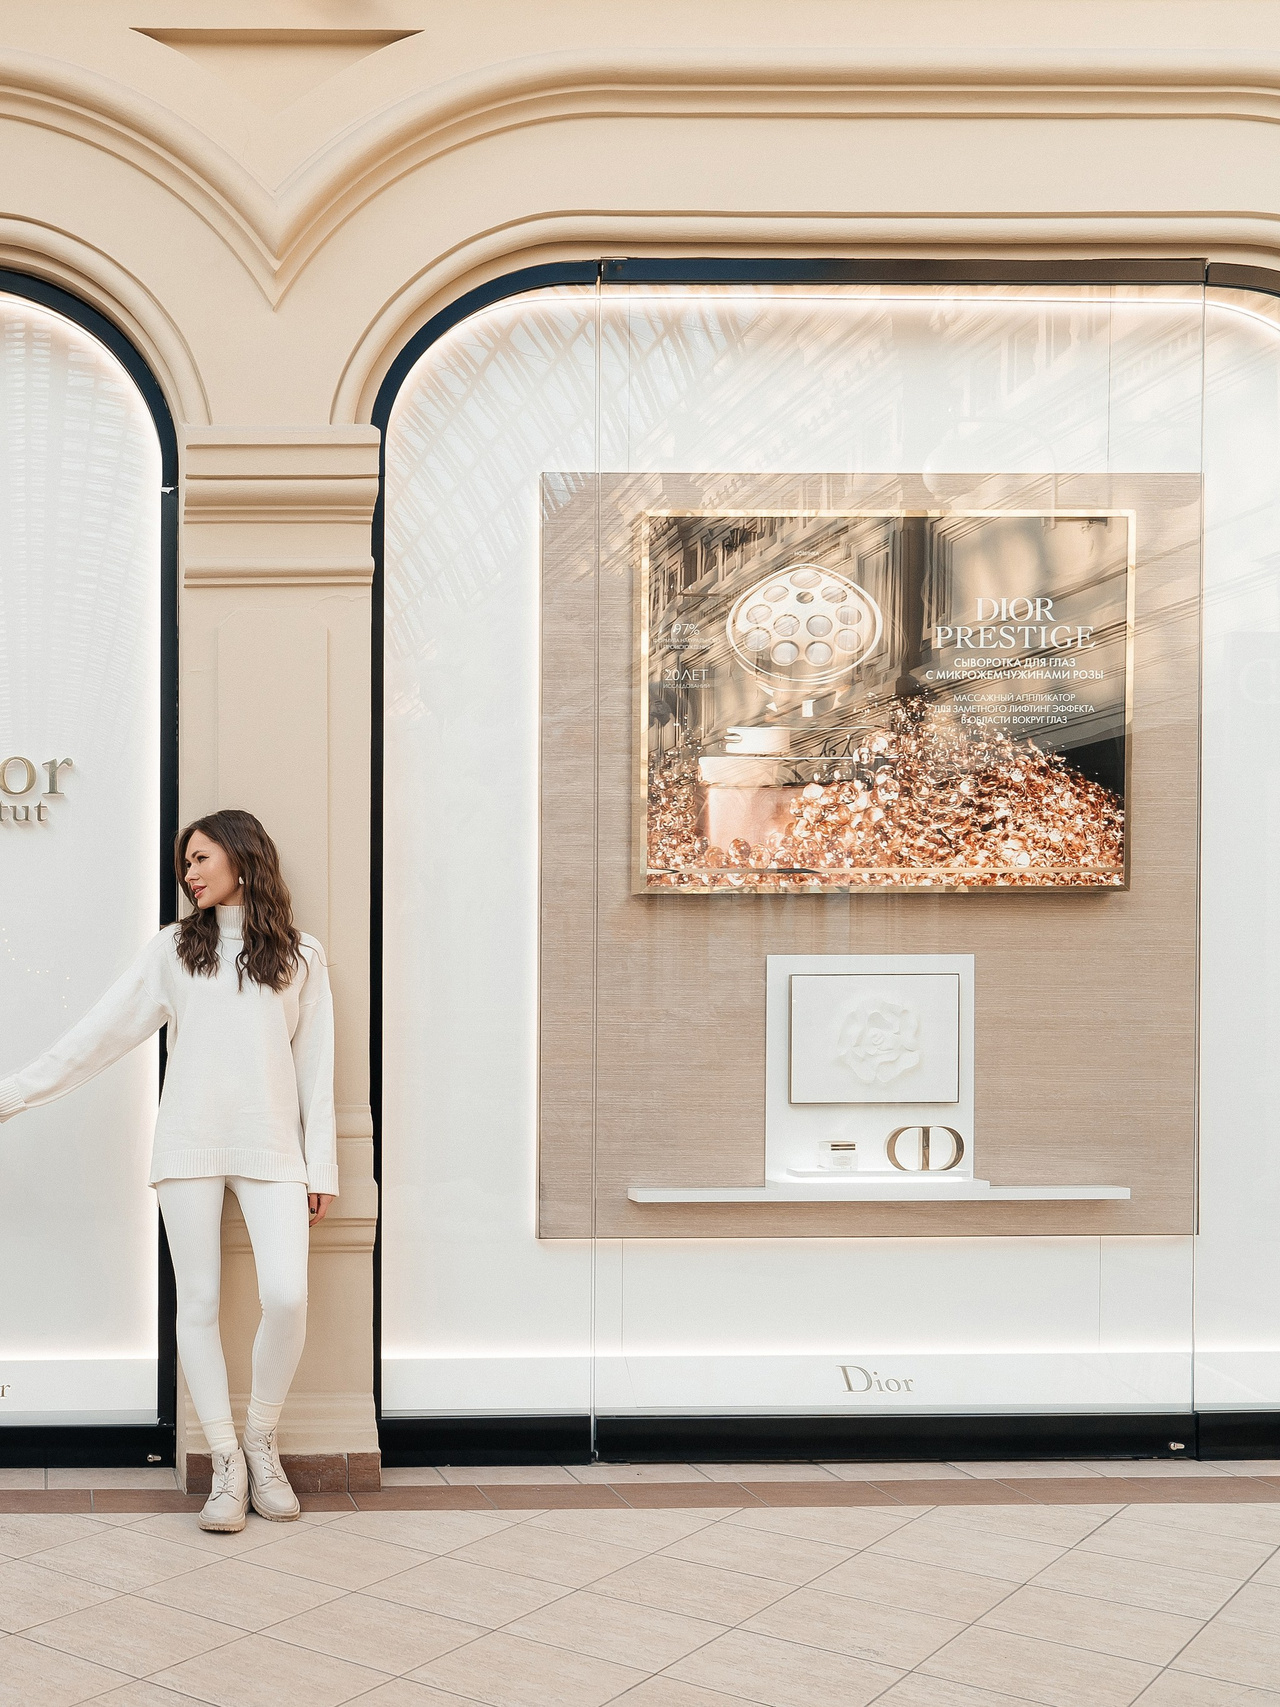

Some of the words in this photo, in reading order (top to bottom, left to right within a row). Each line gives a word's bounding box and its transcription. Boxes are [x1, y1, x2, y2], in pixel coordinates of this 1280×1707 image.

[975, 597, 1056, 622] DIOR
[674, 623, 700, 635] 97%
[934, 625, 1097, 649] PRESTIGE
[953, 658, 1021, 668] СЫВОРОТКА
[1023, 658, 1047, 669] ДЛЯ
[1049, 658, 1076, 668] ГЛАЗ
[664, 669, 680, 681] 20
[681, 669, 709, 681] ЛЕТ
[925, 670, 934, 680] С
[936, 670, 1071, 680] МИКРОЖЕМЧУЖИНАМИ
[1073, 670, 1105, 680] РОЗЫ
[953, 693, 1014, 702] МАССАЖНЫЙ
[1015, 693, 1076, 702] АППЛИКАТОР
[934, 705, 951, 714] ДЛЯ
[953, 705, 1007, 713] ЗАМЕТНОГО
[1009, 705, 1051, 713] ЛИФТИНГ
[1052, 705, 1095, 713] ЭФФЕКТА
[969, 716, 1011, 724] ОБЛАСТИ
[1013, 716, 1045, 724] ВОКРУГ
[1046, 716, 1068, 724] ГЛАЗ
[835, 1365, 914, 1392] Dior
